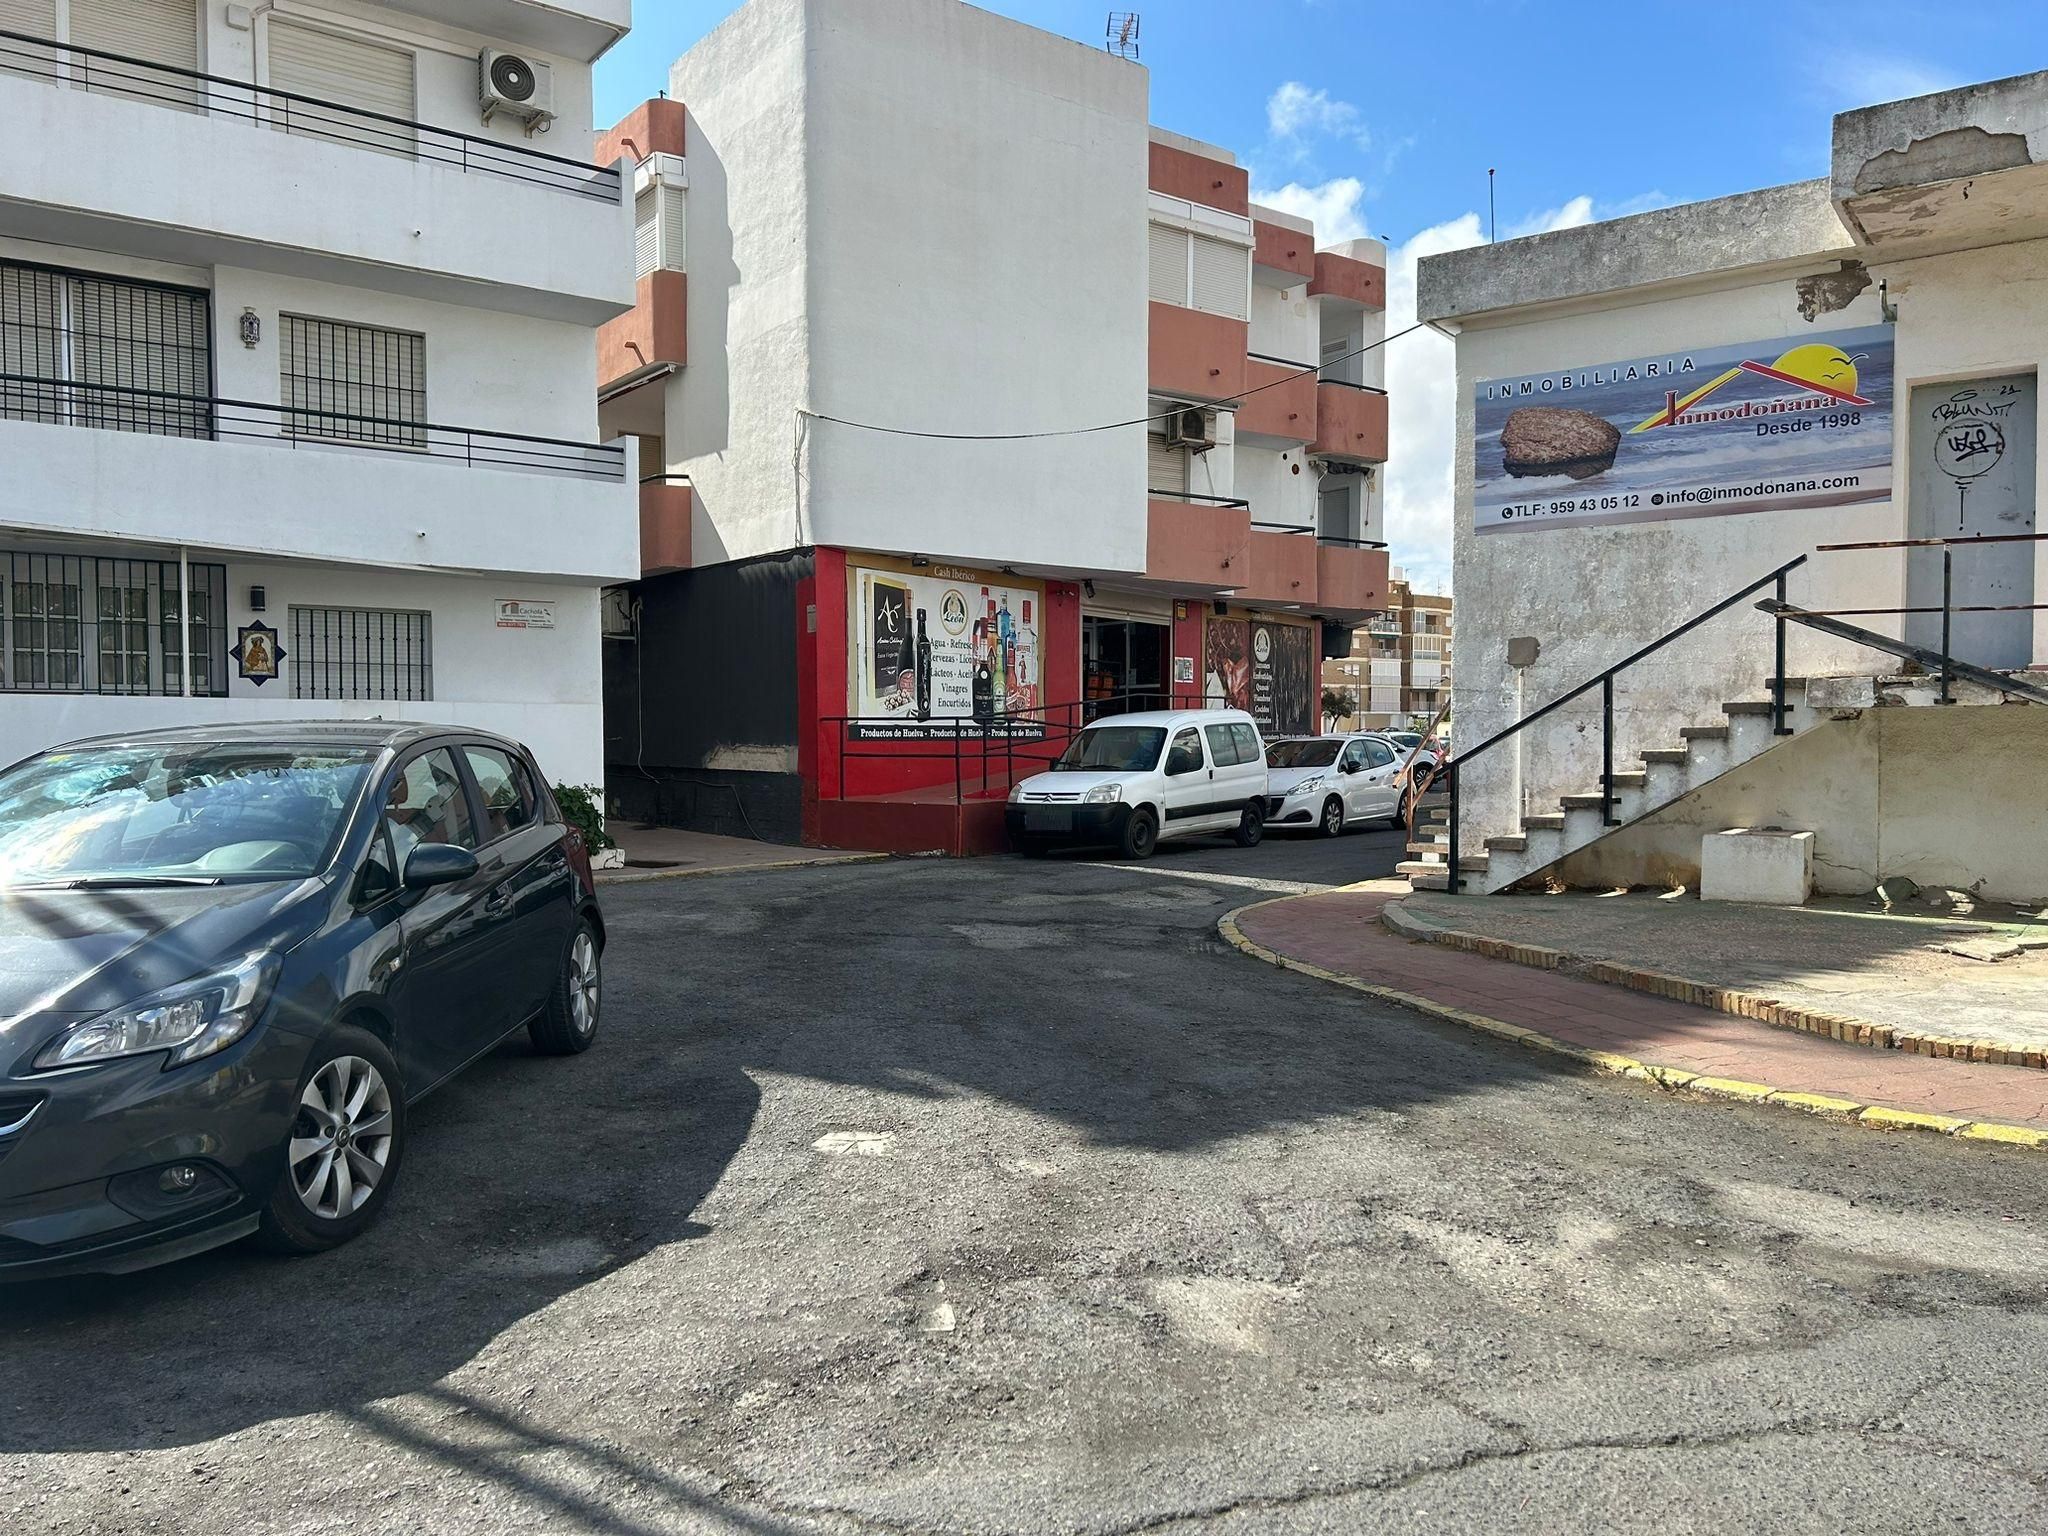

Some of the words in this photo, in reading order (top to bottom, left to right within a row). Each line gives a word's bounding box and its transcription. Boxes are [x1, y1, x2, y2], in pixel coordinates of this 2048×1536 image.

[1488, 358, 1695, 399] INMOBILIARIA
[1665, 390, 1840, 427] Inmodoñana
[1756, 419, 1812, 437] Desde
[1818, 411, 1861, 430] 1998
[1514, 503, 1546, 517] TLF:
[1550, 500, 1575, 514] 959
[1579, 499, 1596, 512] 43
[1601, 496, 1618, 510] 05
[1623, 494, 1639, 507] 12
[1666, 475, 1860, 504] info@inmodonana.com
[934, 566, 950, 577] Cash
[952, 567, 976, 581] Ibérico
[943, 612, 965, 624] León
[930, 638, 946, 650] Agua
[931, 655, 955, 663] ervezas
[941, 683, 968, 695] Vinagres
[938, 697, 971, 708] Encurtidos
[860, 728, 893, 738] Productos
[893, 728, 902, 738] de
[902, 728, 924, 737] Huelva
[930, 728, 957, 738] Producto
[959, 728, 967, 737] de
[967, 728, 984, 737] Huelv
[991, 728, 1017, 737] Produos
[1017, 728, 1025, 737] de
[1025, 728, 1042, 737] Huelva
